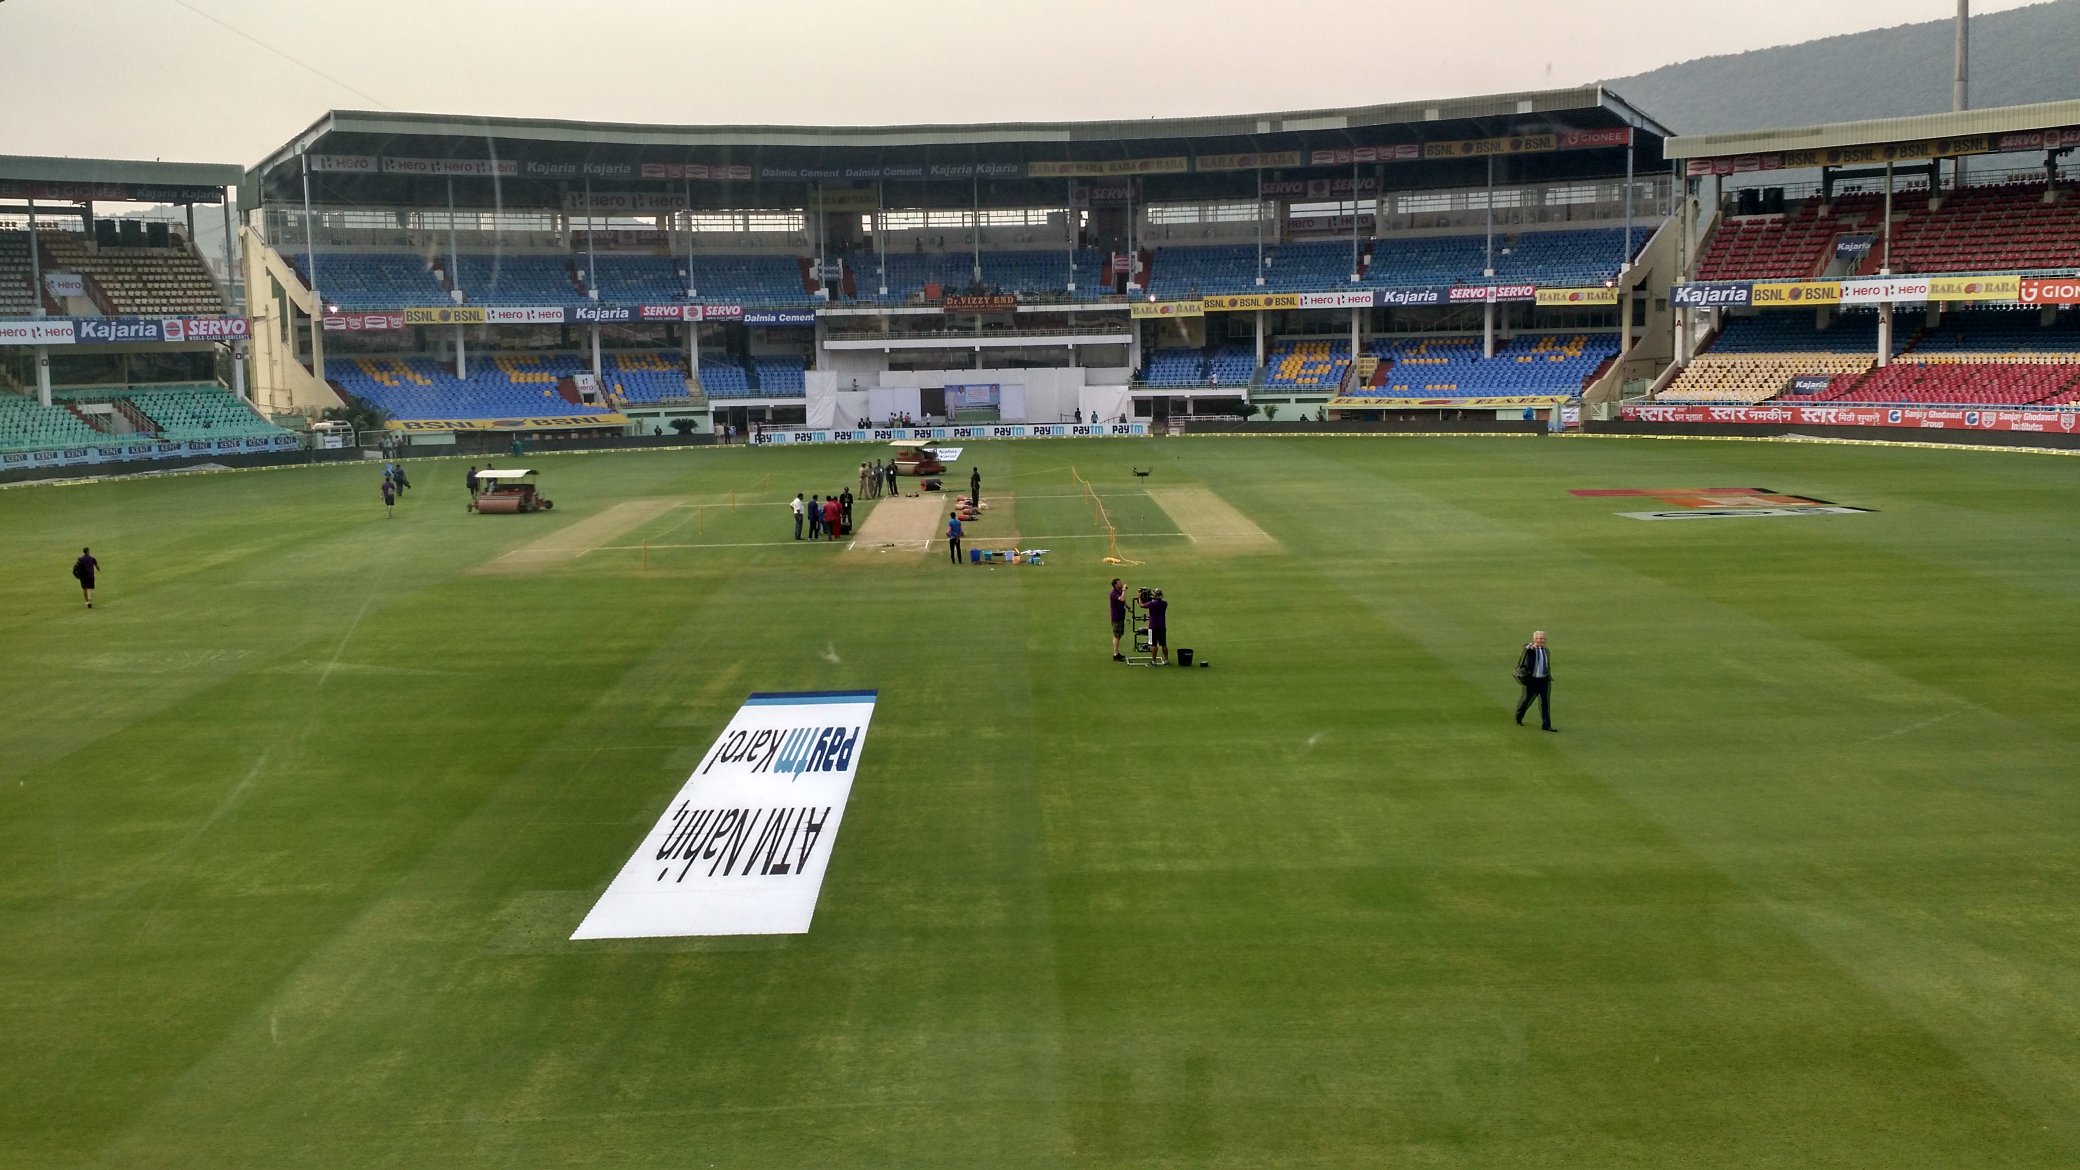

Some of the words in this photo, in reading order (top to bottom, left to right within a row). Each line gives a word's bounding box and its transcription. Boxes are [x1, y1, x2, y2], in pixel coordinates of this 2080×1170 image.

[1581, 131, 1622, 142] GIONEE
[1427, 143, 1454, 157] BSNL
[1475, 140, 1504, 153] BSNL
[1524, 136, 1555, 150] BSNL
[1844, 149, 1876, 162] BSNL
[1900, 145, 1931, 158] BSNL
[1954, 139, 1986, 152] BSNL
[336, 158, 368, 168] Hero
[400, 160, 427, 170] Hero
[445, 161, 472, 171] Hero
[527, 162, 576, 174] Kajaria
[584, 163, 631, 176] Kajaria
[762, 168, 797, 177] Dalmia
[800, 169, 840, 178] Cement
[845, 168, 880, 177] Dalmia
[883, 167, 922, 176] Cement
[931, 165, 973, 176] Kajaria
[976, 163, 1018, 174] Kajaria
[58, 281, 80, 289] Hero
[1853, 287, 1880, 296] Hero
[1898, 285, 1926, 294] Hero
[1931, 283, 1962, 293] BABA
[1985, 282, 2016, 292] BABA
[1384, 291, 1438, 304] Kajaria
[1450, 288, 1486, 298] SERVO
[1497, 286, 1533, 297] SERVO
[1675, 286, 1747, 305] Kajaria
[1754, 289, 1785, 300] BSNL
[1805, 287, 1837, 299] BSNL
[947, 297, 990, 305] Dr.VIZZY
[994, 296, 1014, 304] END
[1204, 300, 1226, 308] BSNL
[1240, 298, 1261, 307] BSNL
[1275, 297, 1297, 306] BSNL
[1311, 297, 1333, 305] Hero
[1348, 295, 1371, 303] Hero
[406, 310, 436, 321] BSNL
[454, 310, 483, 321] BSNL
[498, 311, 523, 319] Hero
[538, 310, 562, 319] Hero
[576, 308, 629, 321] Kajaria
[643, 306, 679, 316] SERVO
[706, 305, 741, 315] SERVO
[744, 314, 775, 322] Dalmia
[779, 313, 814, 322] Cement
[0, 328, 26, 337] Hero
[45, 328, 73, 336] Hero
[81, 321, 157, 341] Kajaria
[189, 320, 246, 335] SERVO
[1795, 380, 1827, 389] Kajaria
[1636, 407, 1676, 421] स्टार
[1710, 406, 1749, 420] स्टार
[1749, 408, 1792, 421] नमकीन
[1800, 407, 1838, 423] स्टार
[1904, 410, 1928, 419] Sanjay
[1999, 412, 2022, 422] Sanjay
[402, 420, 482, 430] BSNL
[530, 416, 610, 426] BSNL
[702, 729, 788, 775] Karo!
[656, 800, 762, 883] Nahin,
[742, 806, 831, 875] ATM
